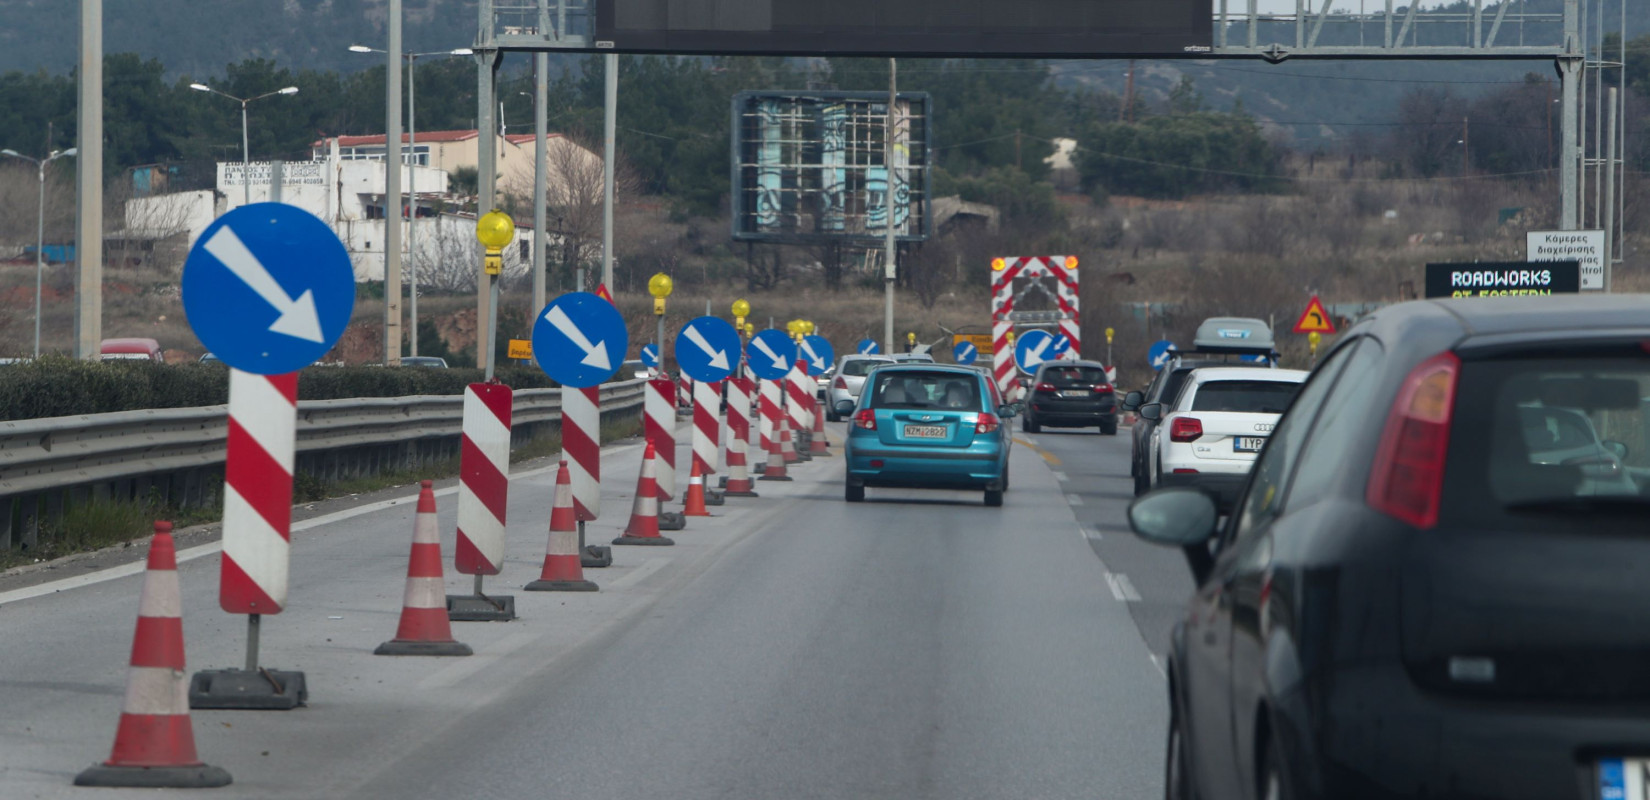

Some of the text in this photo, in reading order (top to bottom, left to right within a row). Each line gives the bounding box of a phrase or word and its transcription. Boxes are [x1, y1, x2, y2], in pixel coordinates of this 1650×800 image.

[1545, 234, 1588, 244] Κάμερες
[1537, 245, 1595, 255] διαχείρισης
[1451, 269, 1551, 287] ROADWORKS
